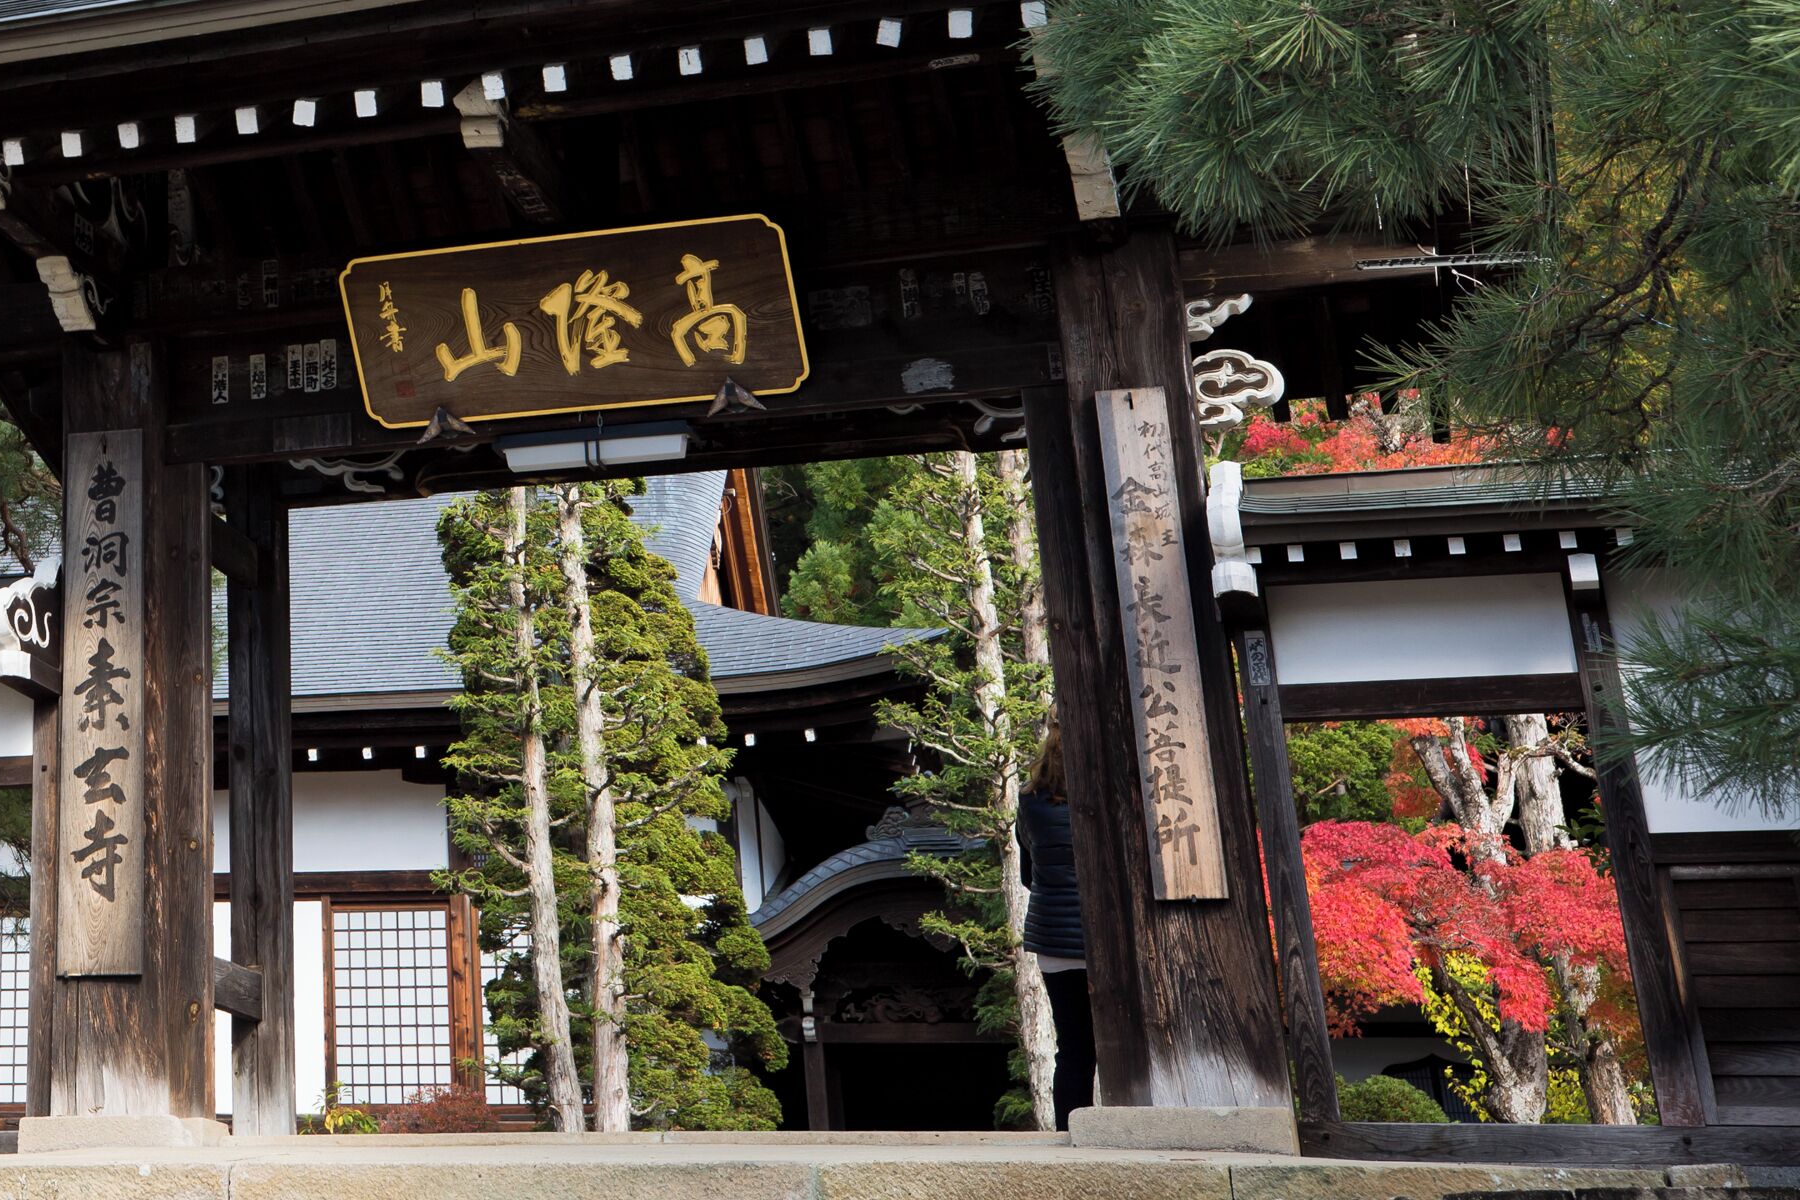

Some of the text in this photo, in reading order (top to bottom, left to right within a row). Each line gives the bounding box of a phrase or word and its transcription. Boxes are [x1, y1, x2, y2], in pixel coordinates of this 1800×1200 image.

[436, 254, 747, 382] 高隆山
[70, 460, 132, 903] 曹洞宗素玄寺
[1111, 476, 1201, 867] 金森長近公菩提所
